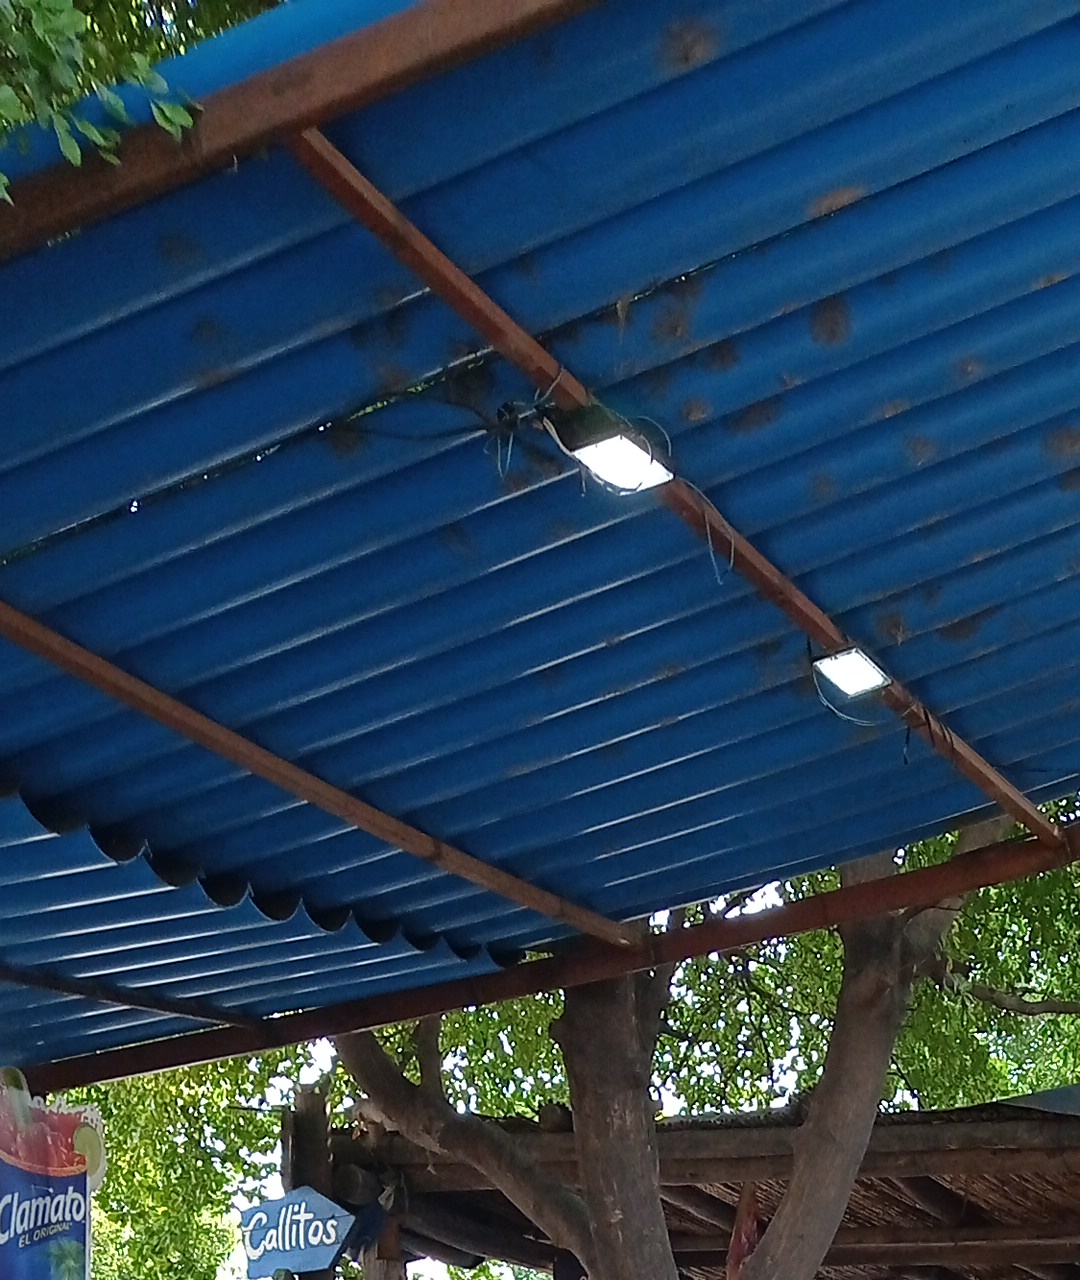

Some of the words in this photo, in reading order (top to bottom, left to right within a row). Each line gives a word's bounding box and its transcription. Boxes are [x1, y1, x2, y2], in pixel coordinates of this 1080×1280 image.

[0, 1186, 86, 1245] Clamato
[18, 1232, 31, 1248] EL
[241, 1201, 338, 1261] Callitos
